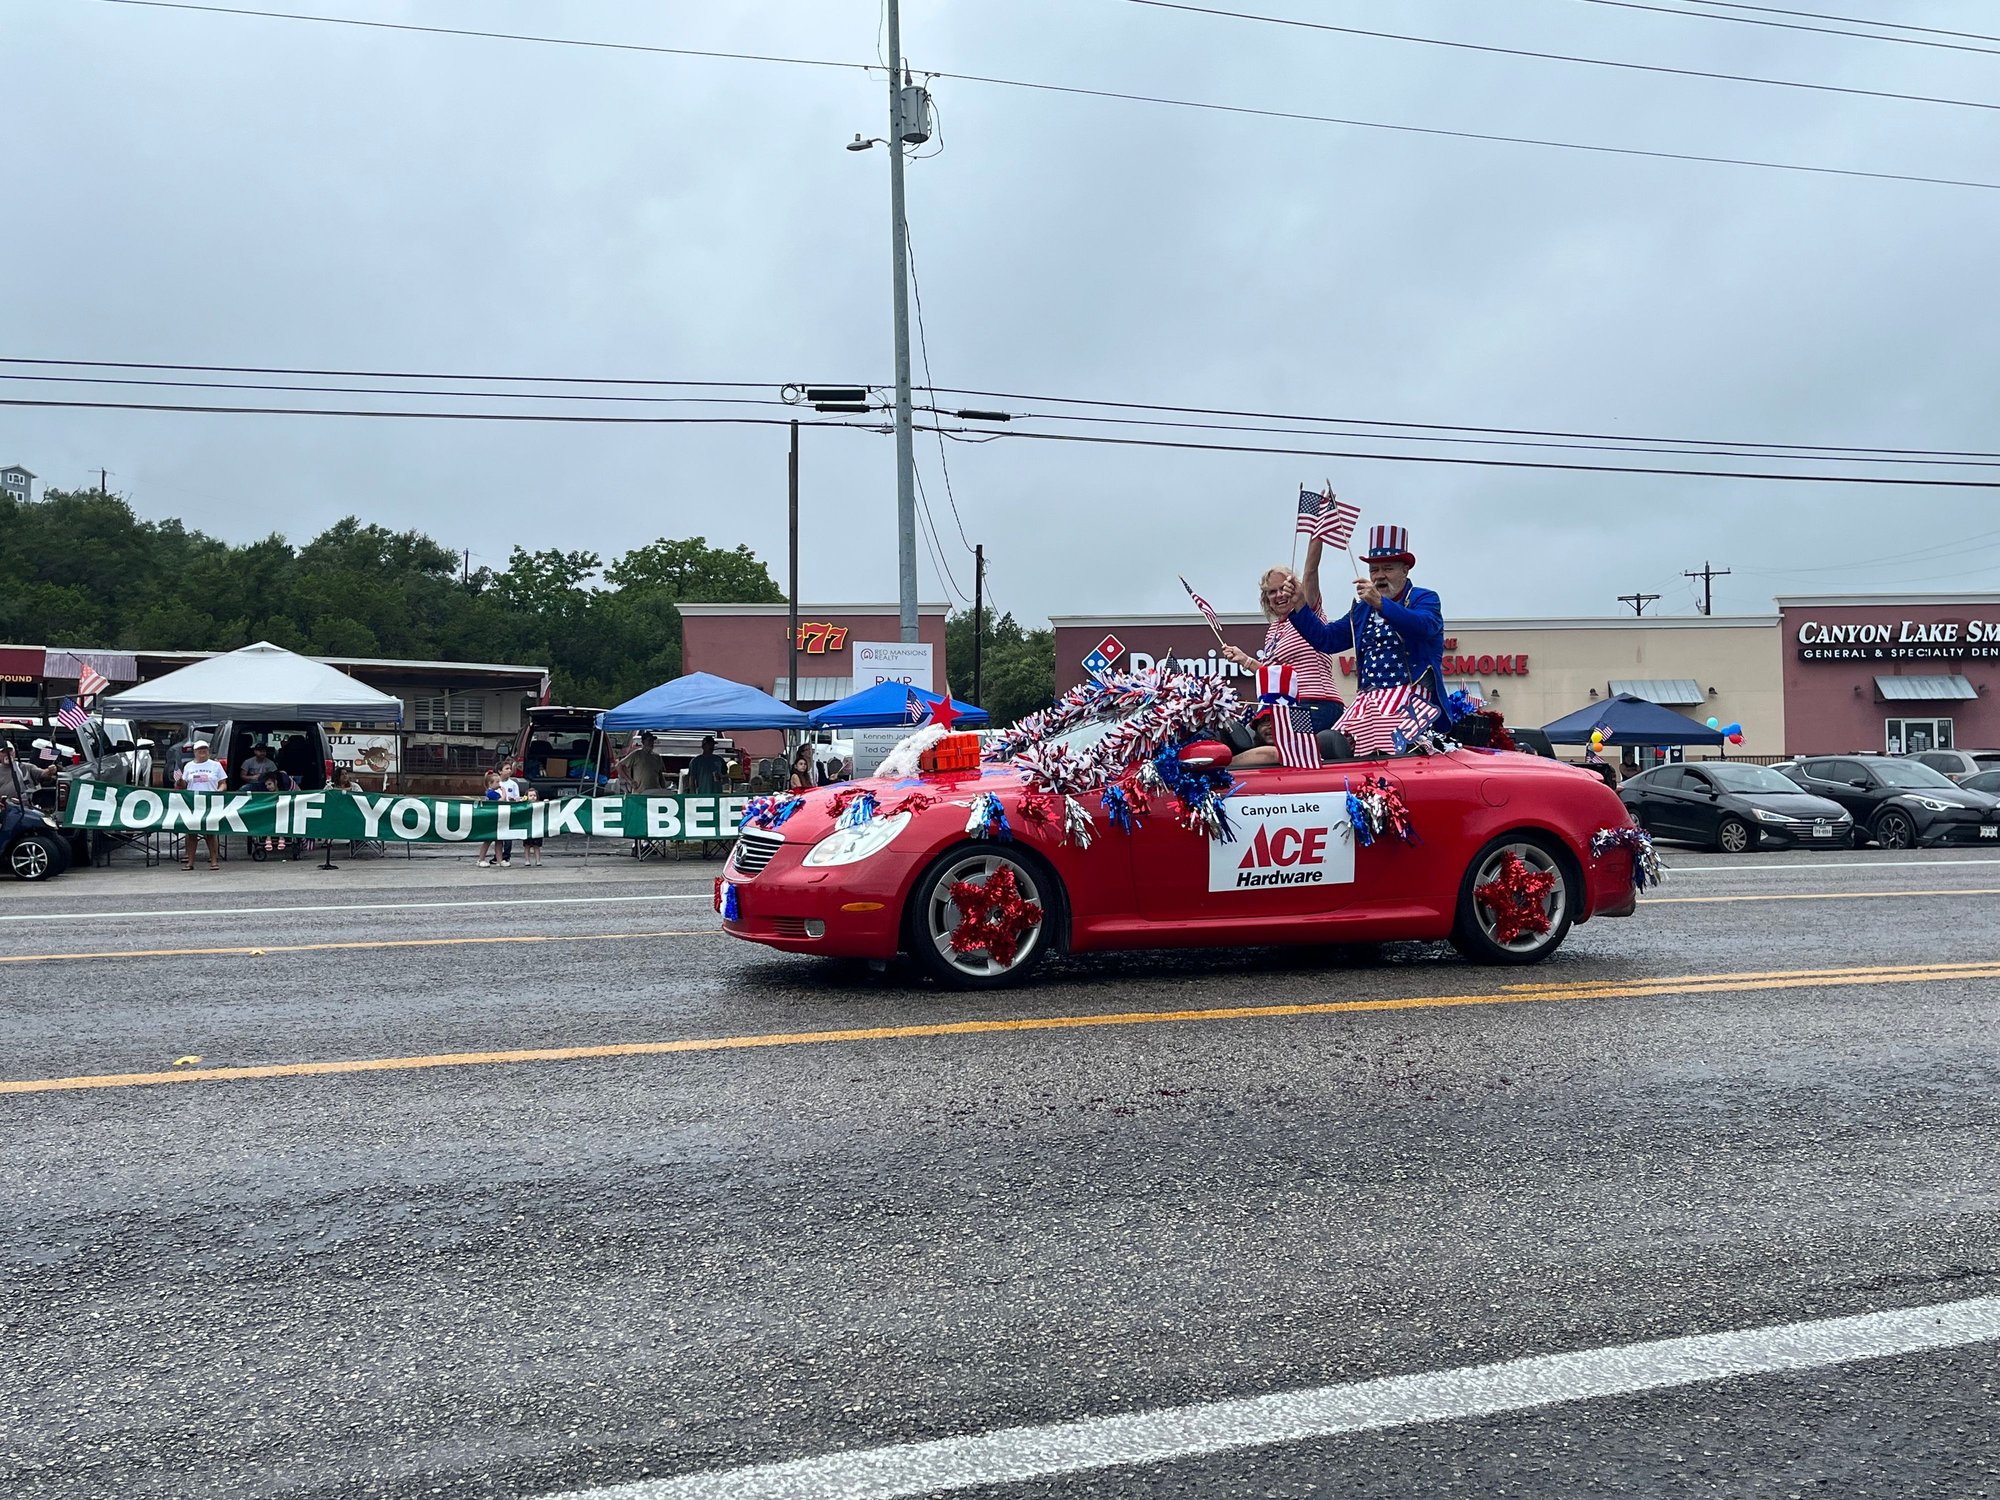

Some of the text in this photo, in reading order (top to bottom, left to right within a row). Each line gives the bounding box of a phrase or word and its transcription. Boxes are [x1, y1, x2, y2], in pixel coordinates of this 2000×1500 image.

[1799, 621, 1892, 643] CANYON
[1899, 620, 1958, 642] LAKE
[890, 649, 927, 657] MANSIONS
[1804, 648, 1999, 658] GENERAL & SPECIALTY DEN
[1442, 654, 1529, 675] SMOKE
[71, 783, 250, 833] HONK
[275, 793, 326, 834] IF
[352, 794, 473, 840] YOU
[496, 797, 625, 840] LIKE
[1241, 803, 1320, 817] Canyon Lake
[1238, 823, 1328, 869] ACE
[1236, 870, 1323, 887] Hardware
